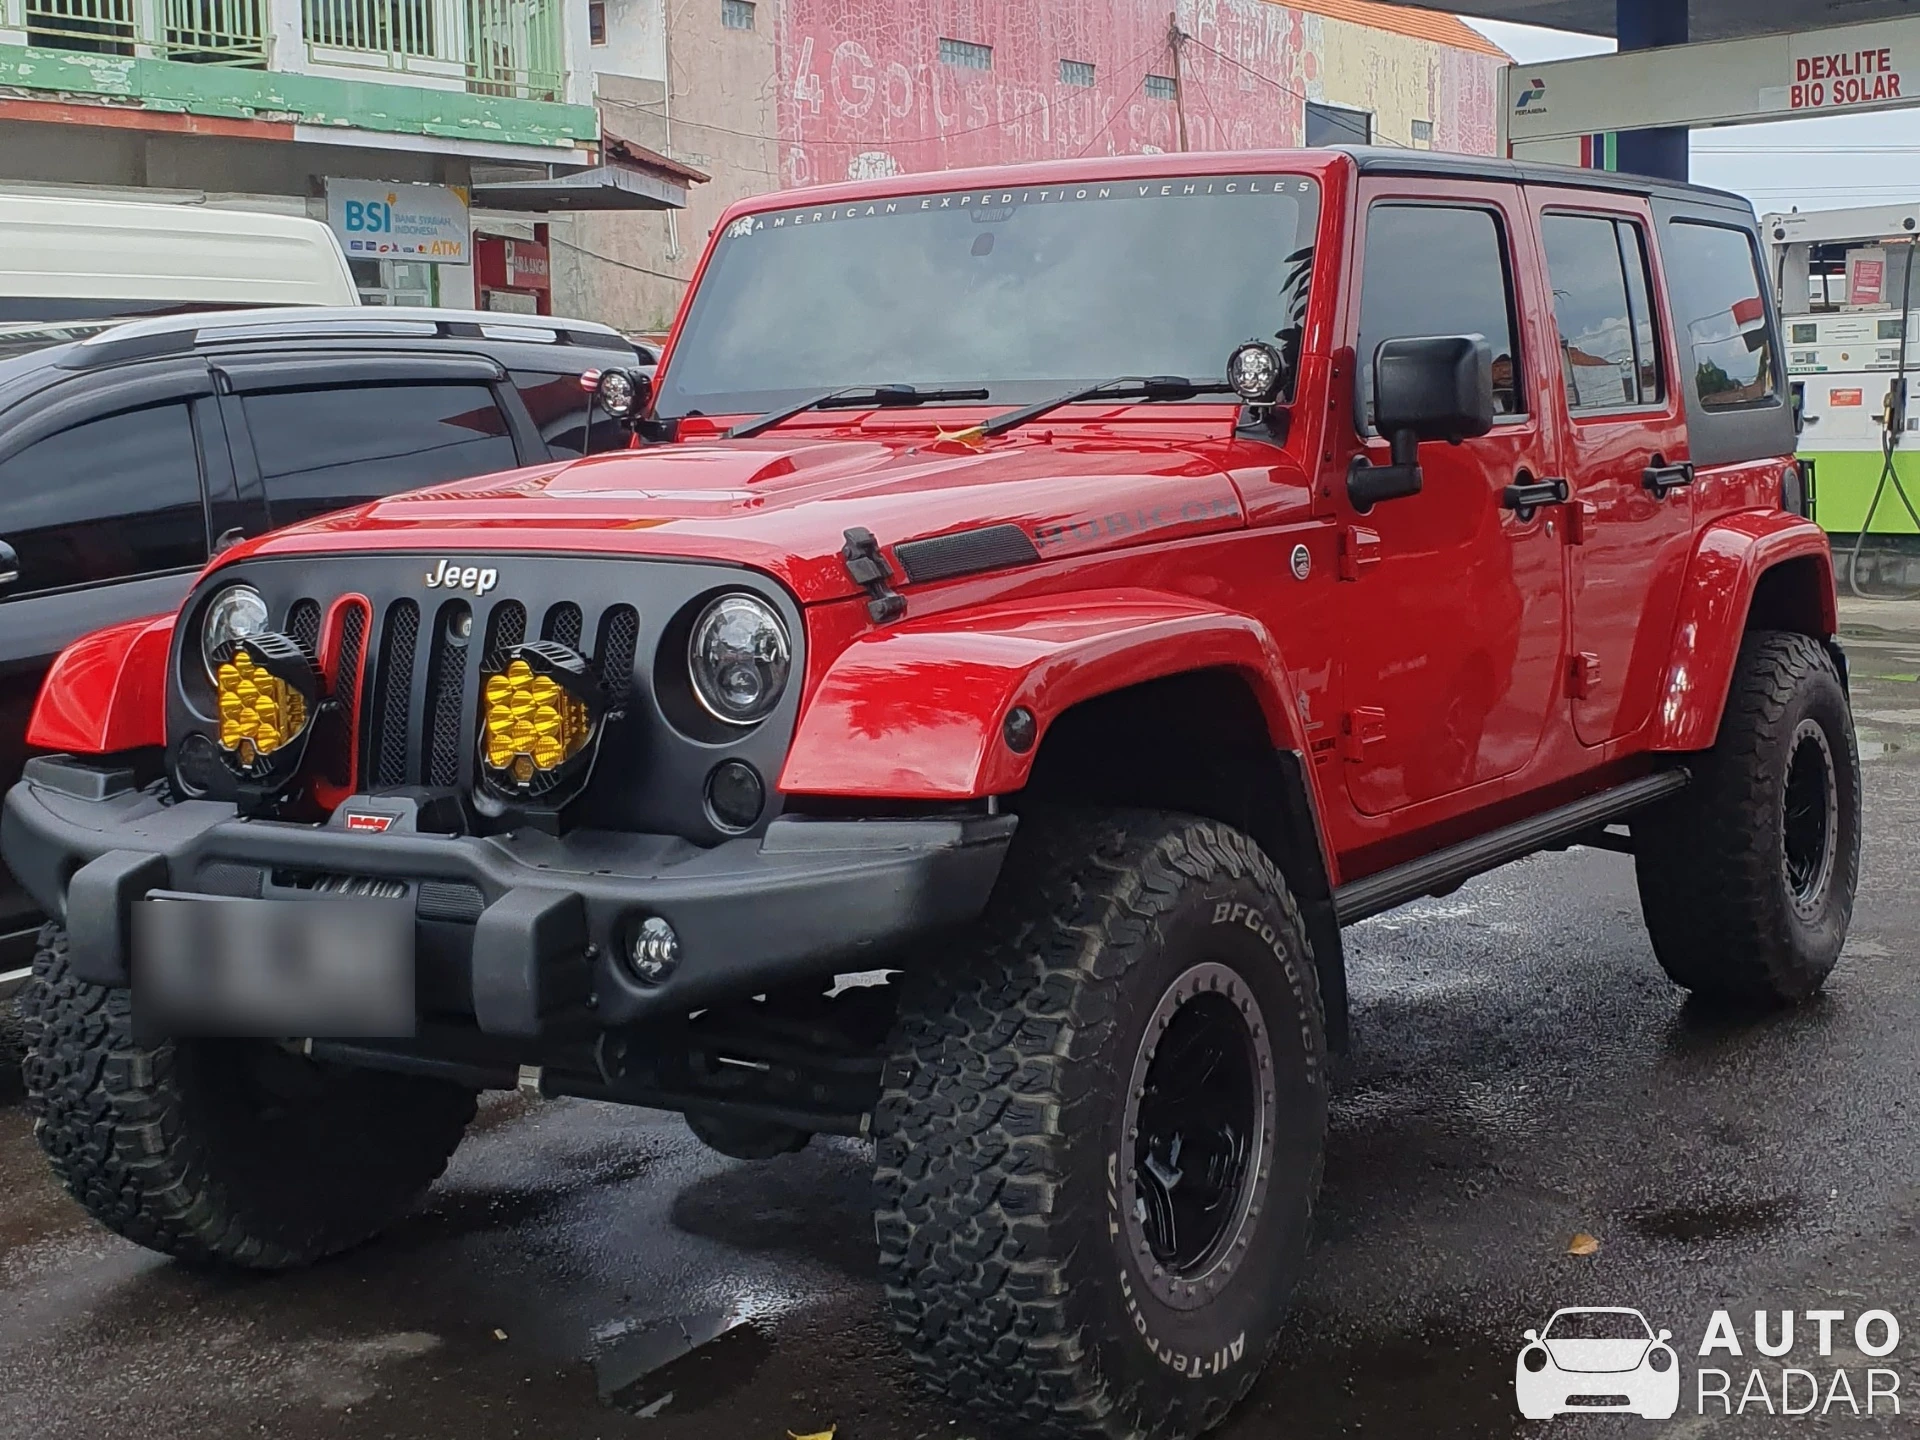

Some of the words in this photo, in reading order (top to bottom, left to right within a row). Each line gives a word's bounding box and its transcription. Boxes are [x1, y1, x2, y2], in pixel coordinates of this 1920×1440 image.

[1797, 48, 1891, 82] DEXLITE
[1791, 82, 1824, 108] BIO
[1833, 74, 1901, 104] SOLAR
[346, 200, 391, 232] BSI
[395, 214, 417, 223] BANK
[755, 203, 898, 231] AMERICAN
[921, 187, 1111, 210] EXPEDITION
[1138, 181, 1310, 198] VEHICLES
[395, 225, 438, 236] INDONESIA
[431, 240, 461, 255] ATM
[1034, 499, 1241, 549] RUBICON
[425, 559, 497, 596] Jeep
